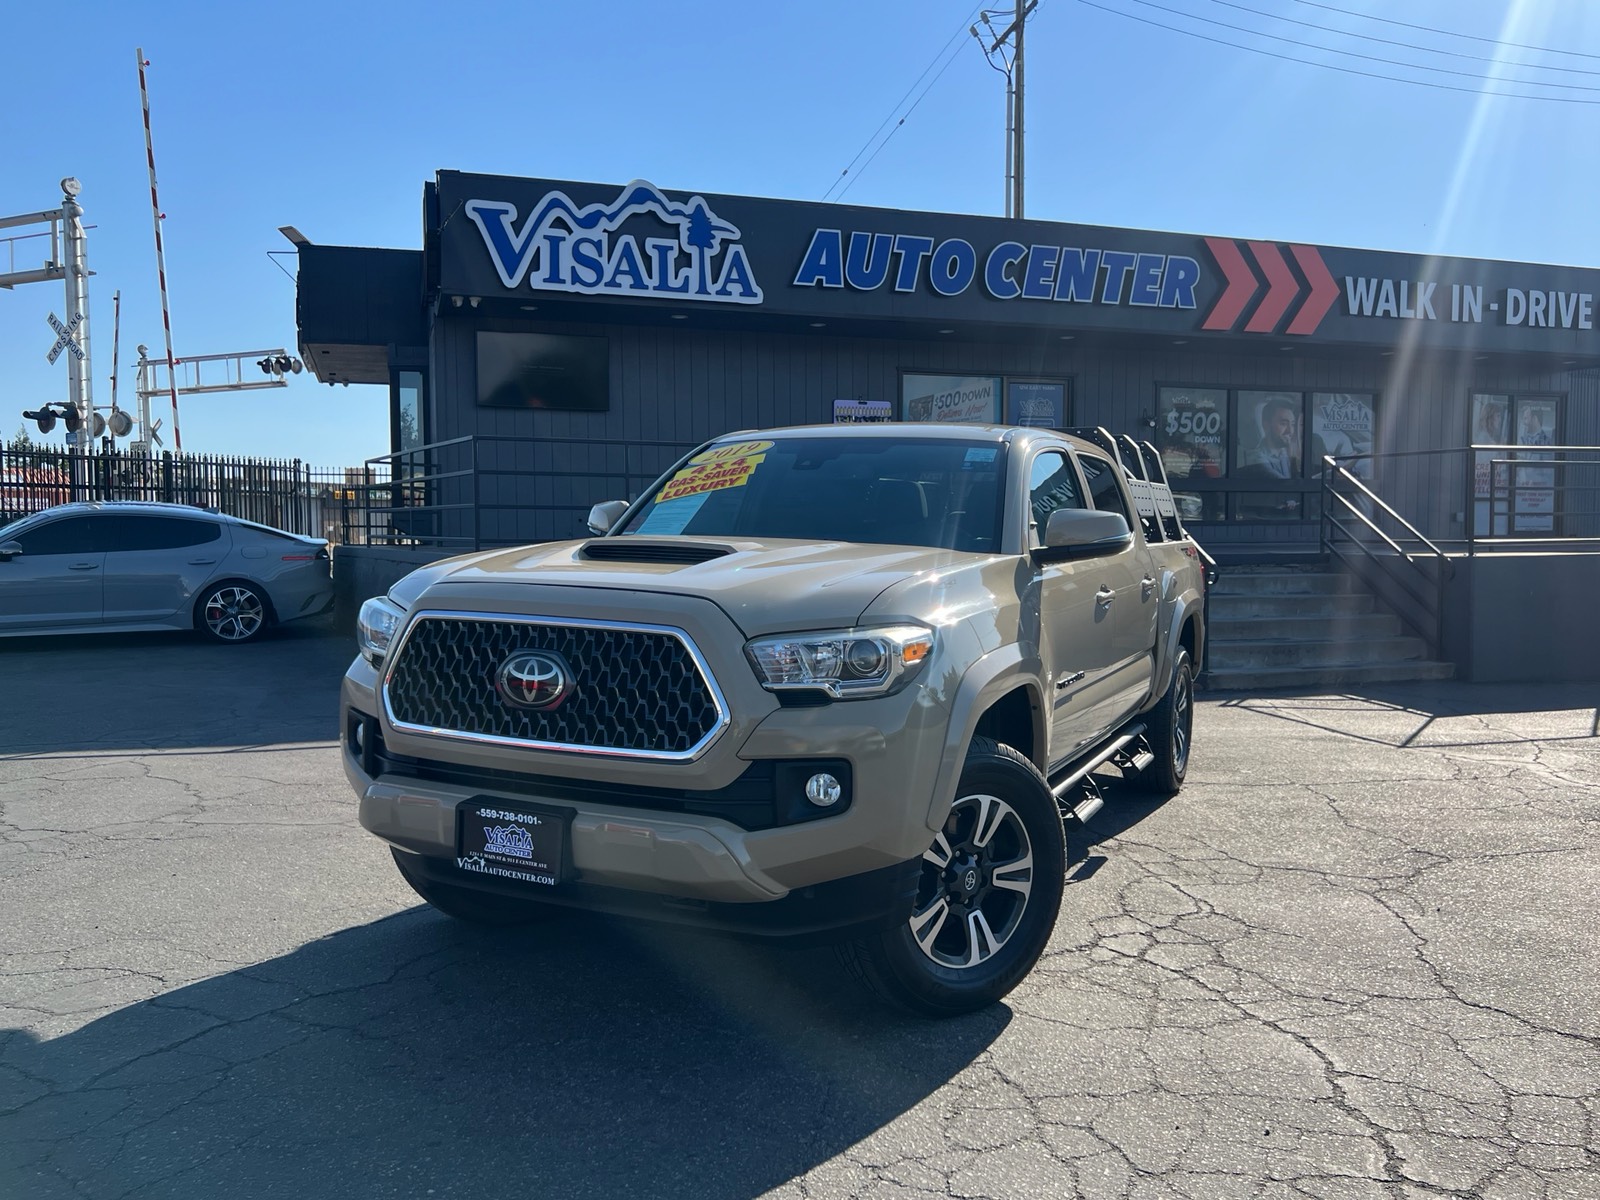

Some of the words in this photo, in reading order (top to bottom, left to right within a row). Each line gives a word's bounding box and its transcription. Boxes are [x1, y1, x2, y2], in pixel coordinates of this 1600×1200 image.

[465, 190, 763, 304] VISALIA
[793, 228, 976, 296] AUTO
[985, 241, 1200, 309] CENTER
[1345, 276, 1437, 320] WALK
[1451, 284, 1482, 323] IN
[1506, 288, 1592, 330] DRIVE
[48, 312, 81, 362] CROSSING
[48, 314, 63, 335] RAIL
[68, 338, 83, 361] ROAD
[934, 391, 961, 410] $500
[961, 386, 991, 403] DOWN
[1321, 400, 1370, 422] VISALIA
[1165, 408, 1221, 436] $500
[702, 442, 761, 462] 2019
[661, 476, 743, 500] LUXURY
[484, 824, 534, 850] VISALIA
[484, 843, 503, 854] AUTO
[504, 847, 532, 858] CENTER
